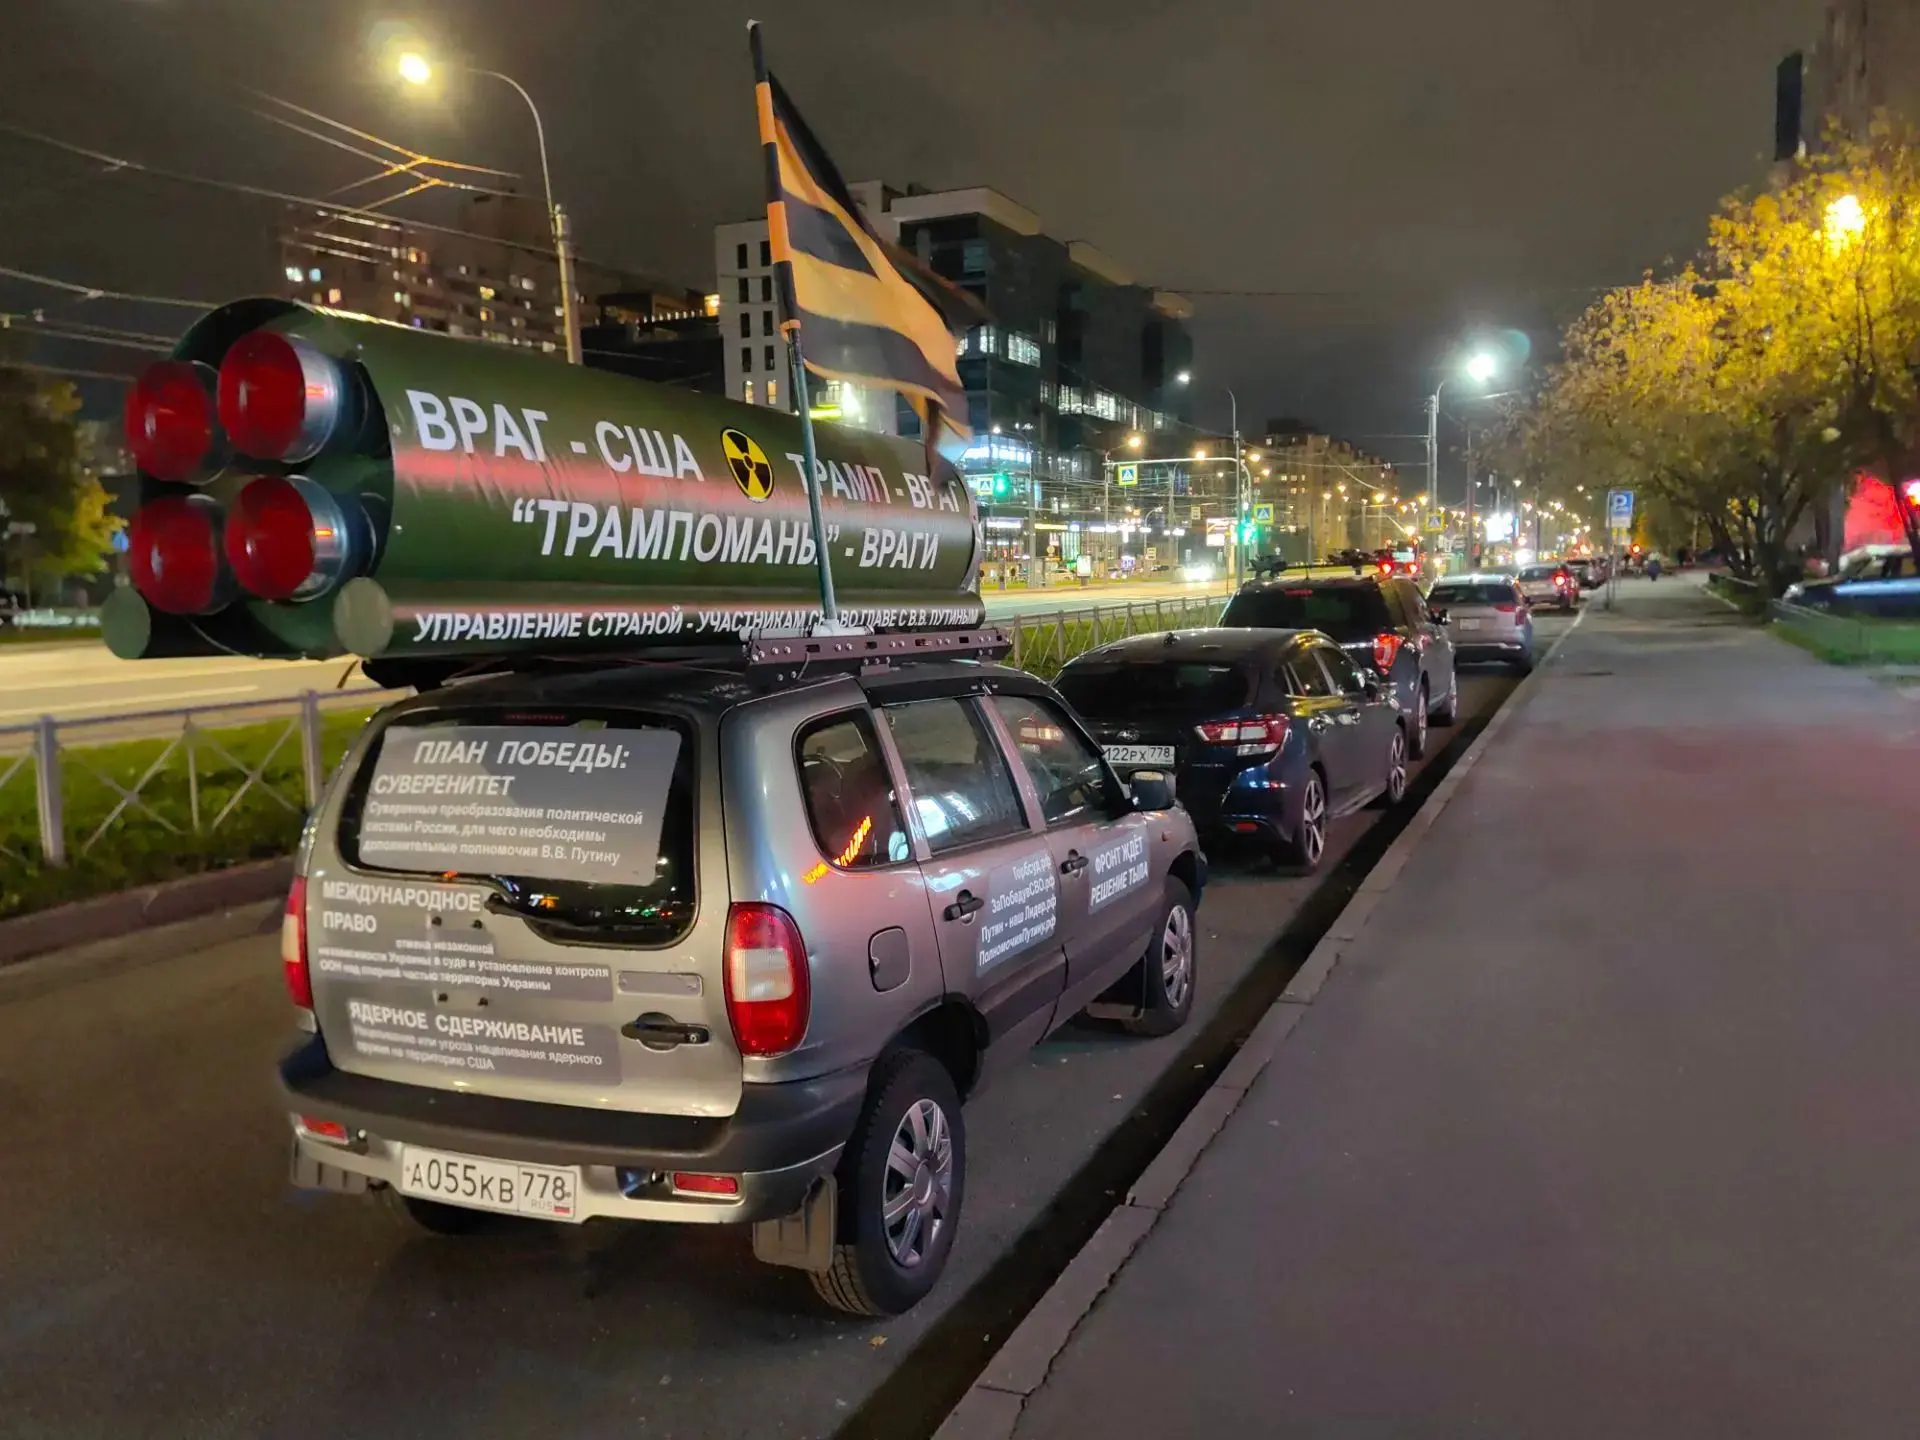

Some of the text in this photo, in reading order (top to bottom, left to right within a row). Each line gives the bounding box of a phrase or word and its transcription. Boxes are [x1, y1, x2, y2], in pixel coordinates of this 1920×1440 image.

[406, 389, 548, 463] ВРАГ
[595, 421, 704, 481] США
[785, 452, 891, 504] ТРАМП
[859, 527, 939, 570] ВРАГИ
[412, 612, 583, 642] УПРАВЛЕНИЕ
[587, 604, 684, 637] СТРАНОЙ
[695, 609, 806, 634] УЧАСТНИКАМ
[860, 608, 898, 628] ГЛАВЕ
[898, 608, 907, 627] С
[907, 609, 927, 627] В.В.
[928, 608, 979, 626] ПУТИНЫМ
[413, 740, 630, 773] ПЛАН ПОБЕДЫ:
[1104, 747, 1170, 762] 122РХ 778
[374, 774, 515, 796] СУВЕРЕНИТЕТ
[440, 802, 544, 818] преобразования
[547, 807, 644, 825] политической
[461, 823, 485, 837] для
[488, 825, 517, 837] чего
[519, 825, 607, 843] необходимы
[460, 842, 538, 858] полномочия
[541, 844, 568, 860] В.В.
[571, 846, 620, 866] Путину
[1094, 846, 1121, 875] ФРОНТ
[1090, 861, 1149, 907] РЕШЕНИЕ ТЫЛА
[322, 881, 481, 913] МЕЖДУНАРОДНОЕ
[322, 911, 377, 934] ПРАВО
[981, 921, 1004, 944] Путин
[477, 960, 553, 975] установление
[555, 966, 609, 979] контроля
[501, 976, 551, 992] Украины
[349, 1001, 586, 1046] ЯДЕРНОЕ СДЕРЖИВАНИЕ
[467, 1056, 496, 1071] США
[548, 1050, 603, 1068] ядерного
[410, 1158, 566, 1204] А055КВ 778
